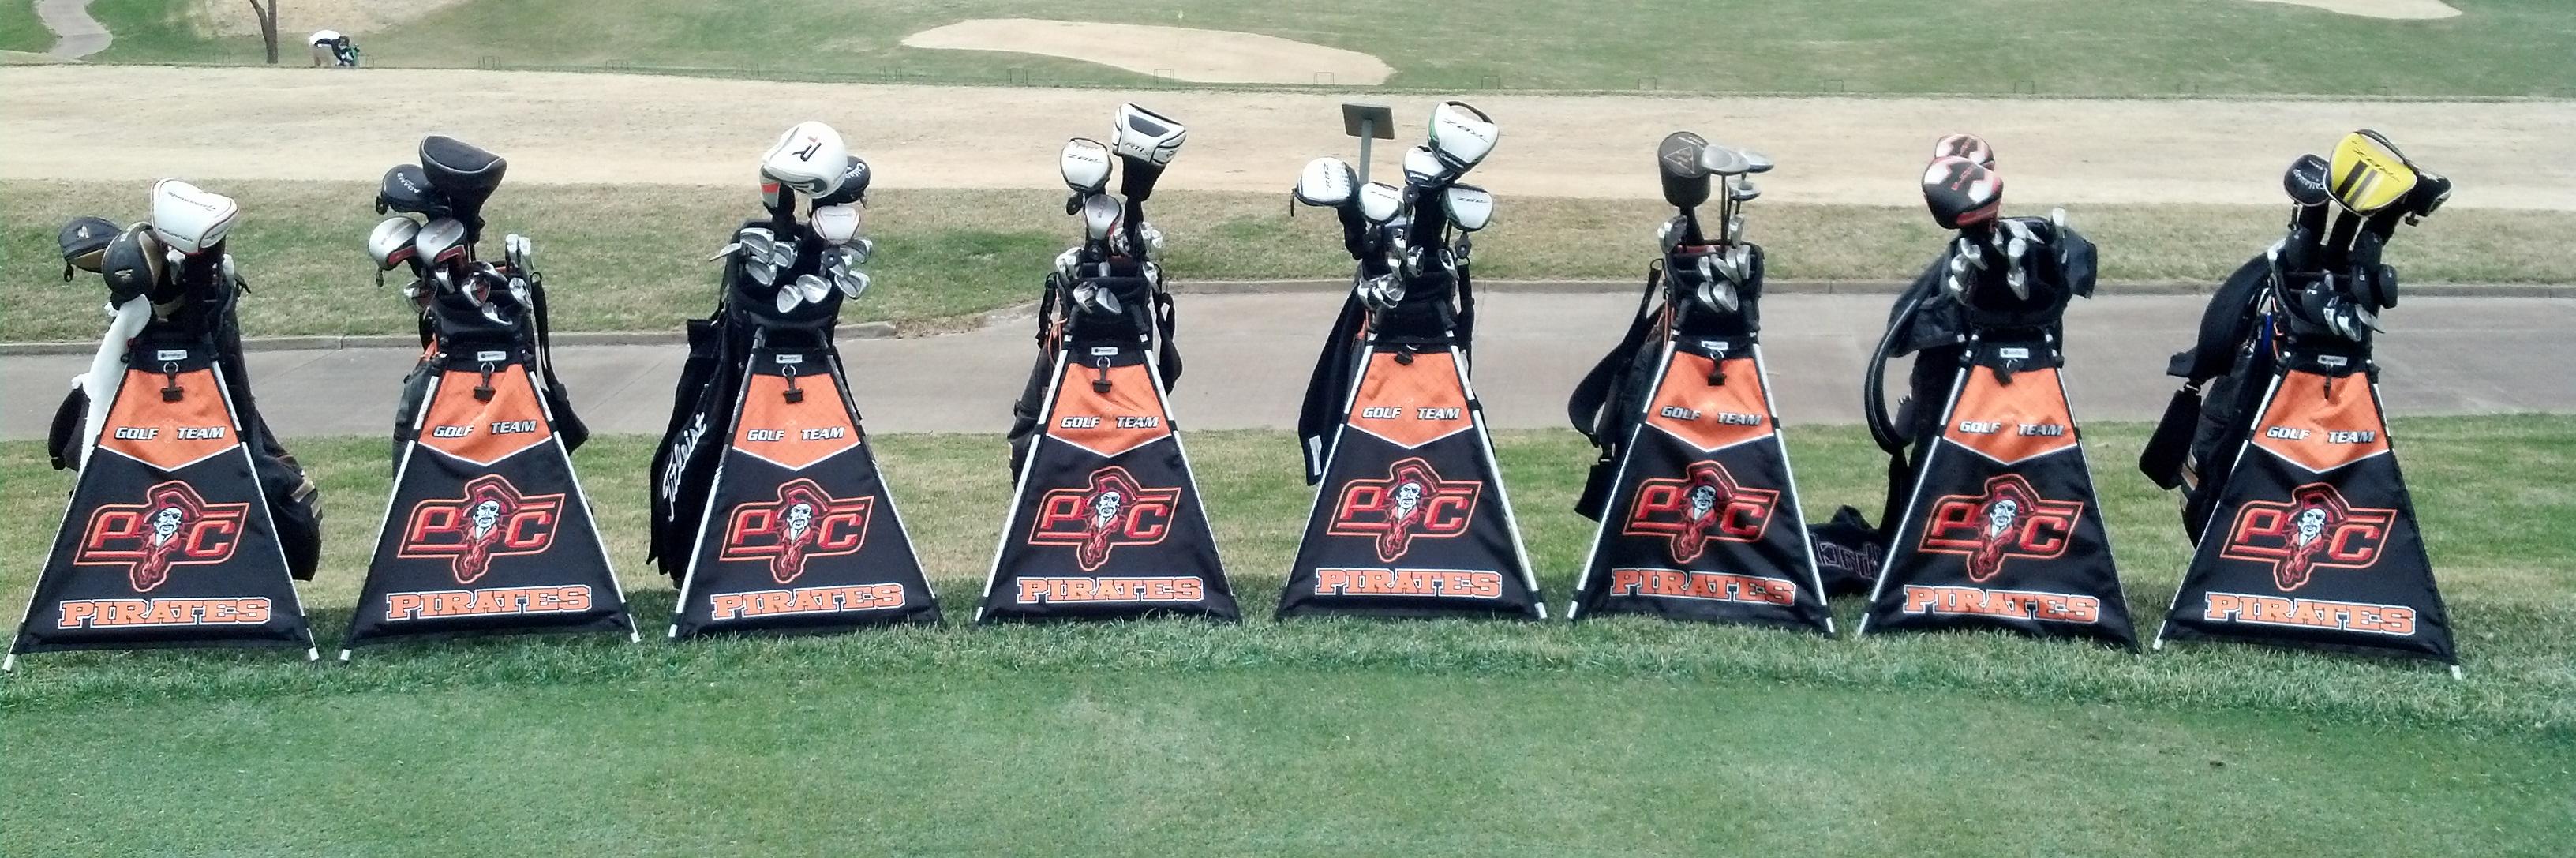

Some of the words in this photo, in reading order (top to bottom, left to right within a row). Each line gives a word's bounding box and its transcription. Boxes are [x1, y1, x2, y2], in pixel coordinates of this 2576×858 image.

[1061, 416, 1100, 429] GOLF
[1116, 416, 1159, 428] TEAM
[1362, 407, 1402, 419] GOLF
[1417, 407, 1460, 419] TEAM
[1661, 406, 1701, 421] GOLF
[1717, 411, 1762, 426] TEAM
[114, 427, 159, 440] GOLF
[177, 426, 226, 440] TEAM
[432, 425, 474, 438] GOLF
[491, 421, 537, 434] TEAM
[747, 429, 784, 441] GOLF
[801, 427, 845, 440] TEAM
[1959, 421, 2001, 434] GOLF
[2017, 423, 2064, 436] TEAM
[2267, 425, 2311, 440] GOLF
[2327, 430, 2376, 444] TEAM
[662, 411, 707, 522] Titleist
[1017, 576, 1204, 604] PIRATES
[1315, 568, 1502, 598] PIRATES
[1610, 568, 1796, 606] PIRATES
[58, 597, 271, 630] PIRATES
[386, 585, 591, 620] PIRATES
[711, 583, 905, 620] PIRATES
[1904, 584, 2100, 624] PIRATES
[2204, 592, 2416, 636] PIRATES
